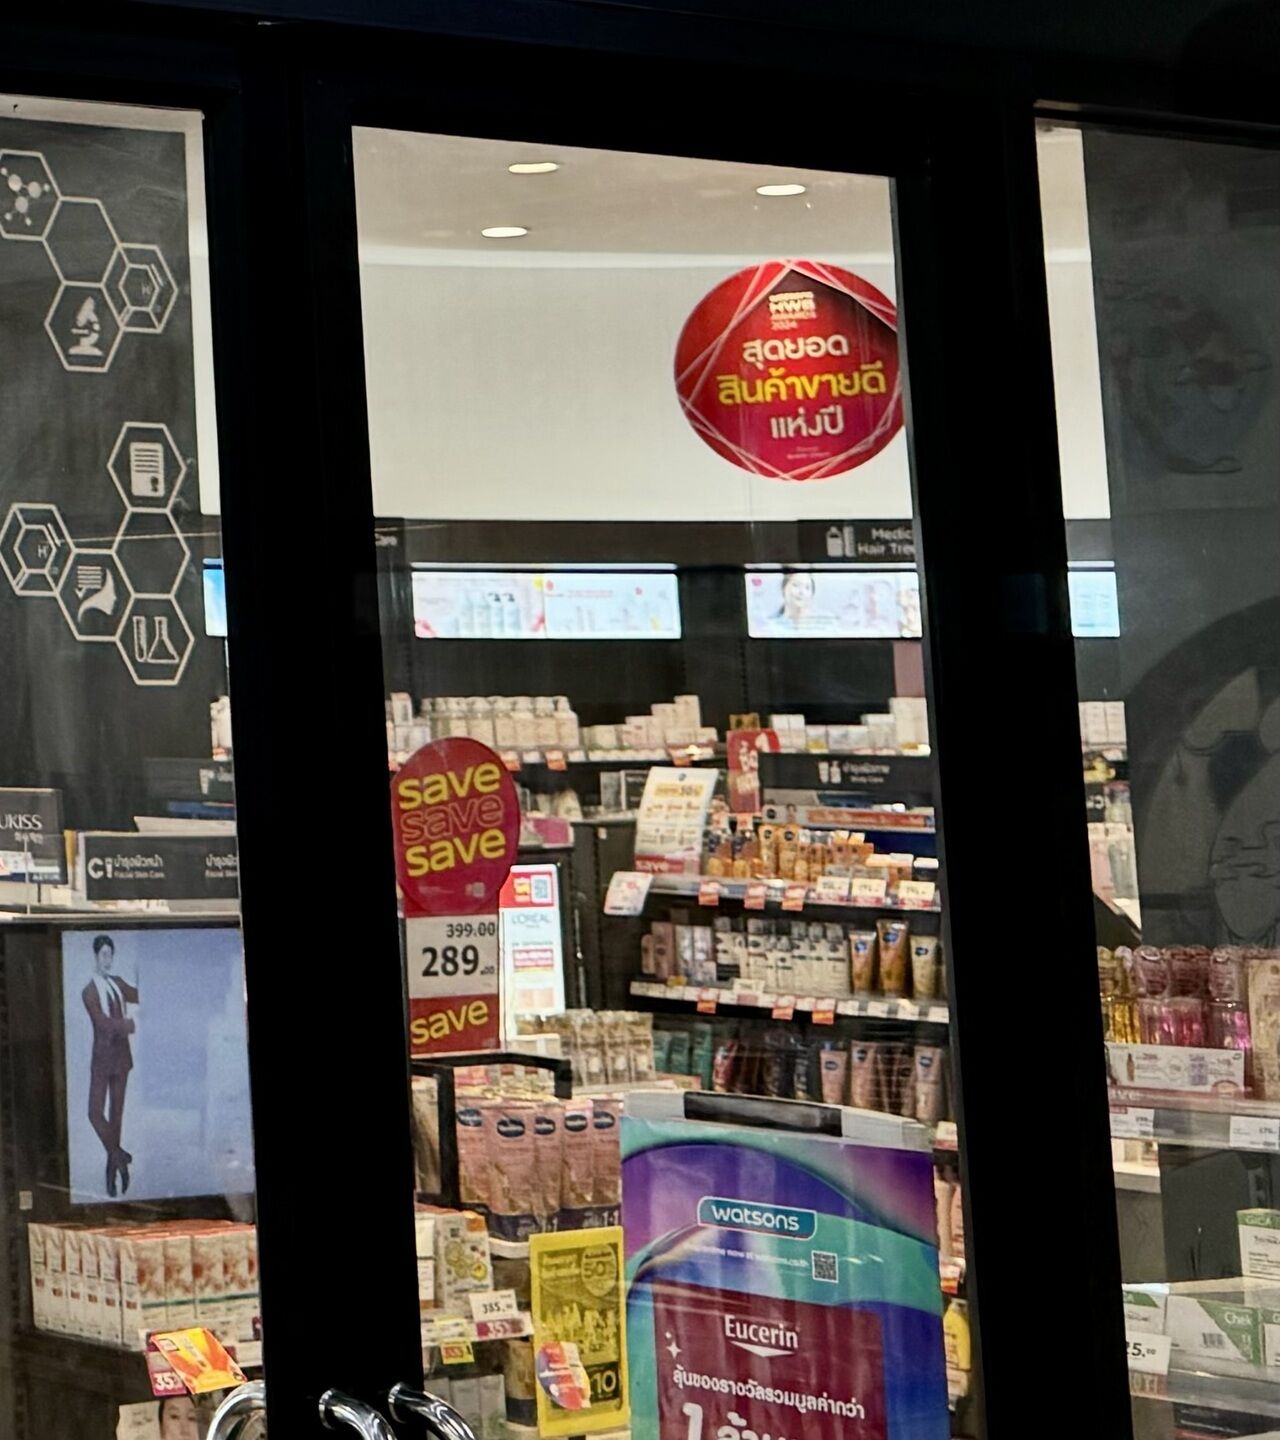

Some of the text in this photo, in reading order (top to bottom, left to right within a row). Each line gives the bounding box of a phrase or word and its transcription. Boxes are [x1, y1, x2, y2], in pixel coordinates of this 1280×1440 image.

[743, 334, 849, 370] สุดยอด
[717, 360, 887, 404] สินค้าขายดี
[770, 404, 844, 439] แห่งปี
[398, 763, 501, 810] save
[401, 794, 504, 846] save
[405, 828, 506, 878] save
[446, 921, 497, 939] 399.00
[410, 999, 489, 1045] save
[711, 1203, 800, 1231] watsons
[725, 1314, 799, 1349] Eucerin
[673, 1364, 865, 1420] ลุ้นของรางวัลรวมมูลค่ากว่า
